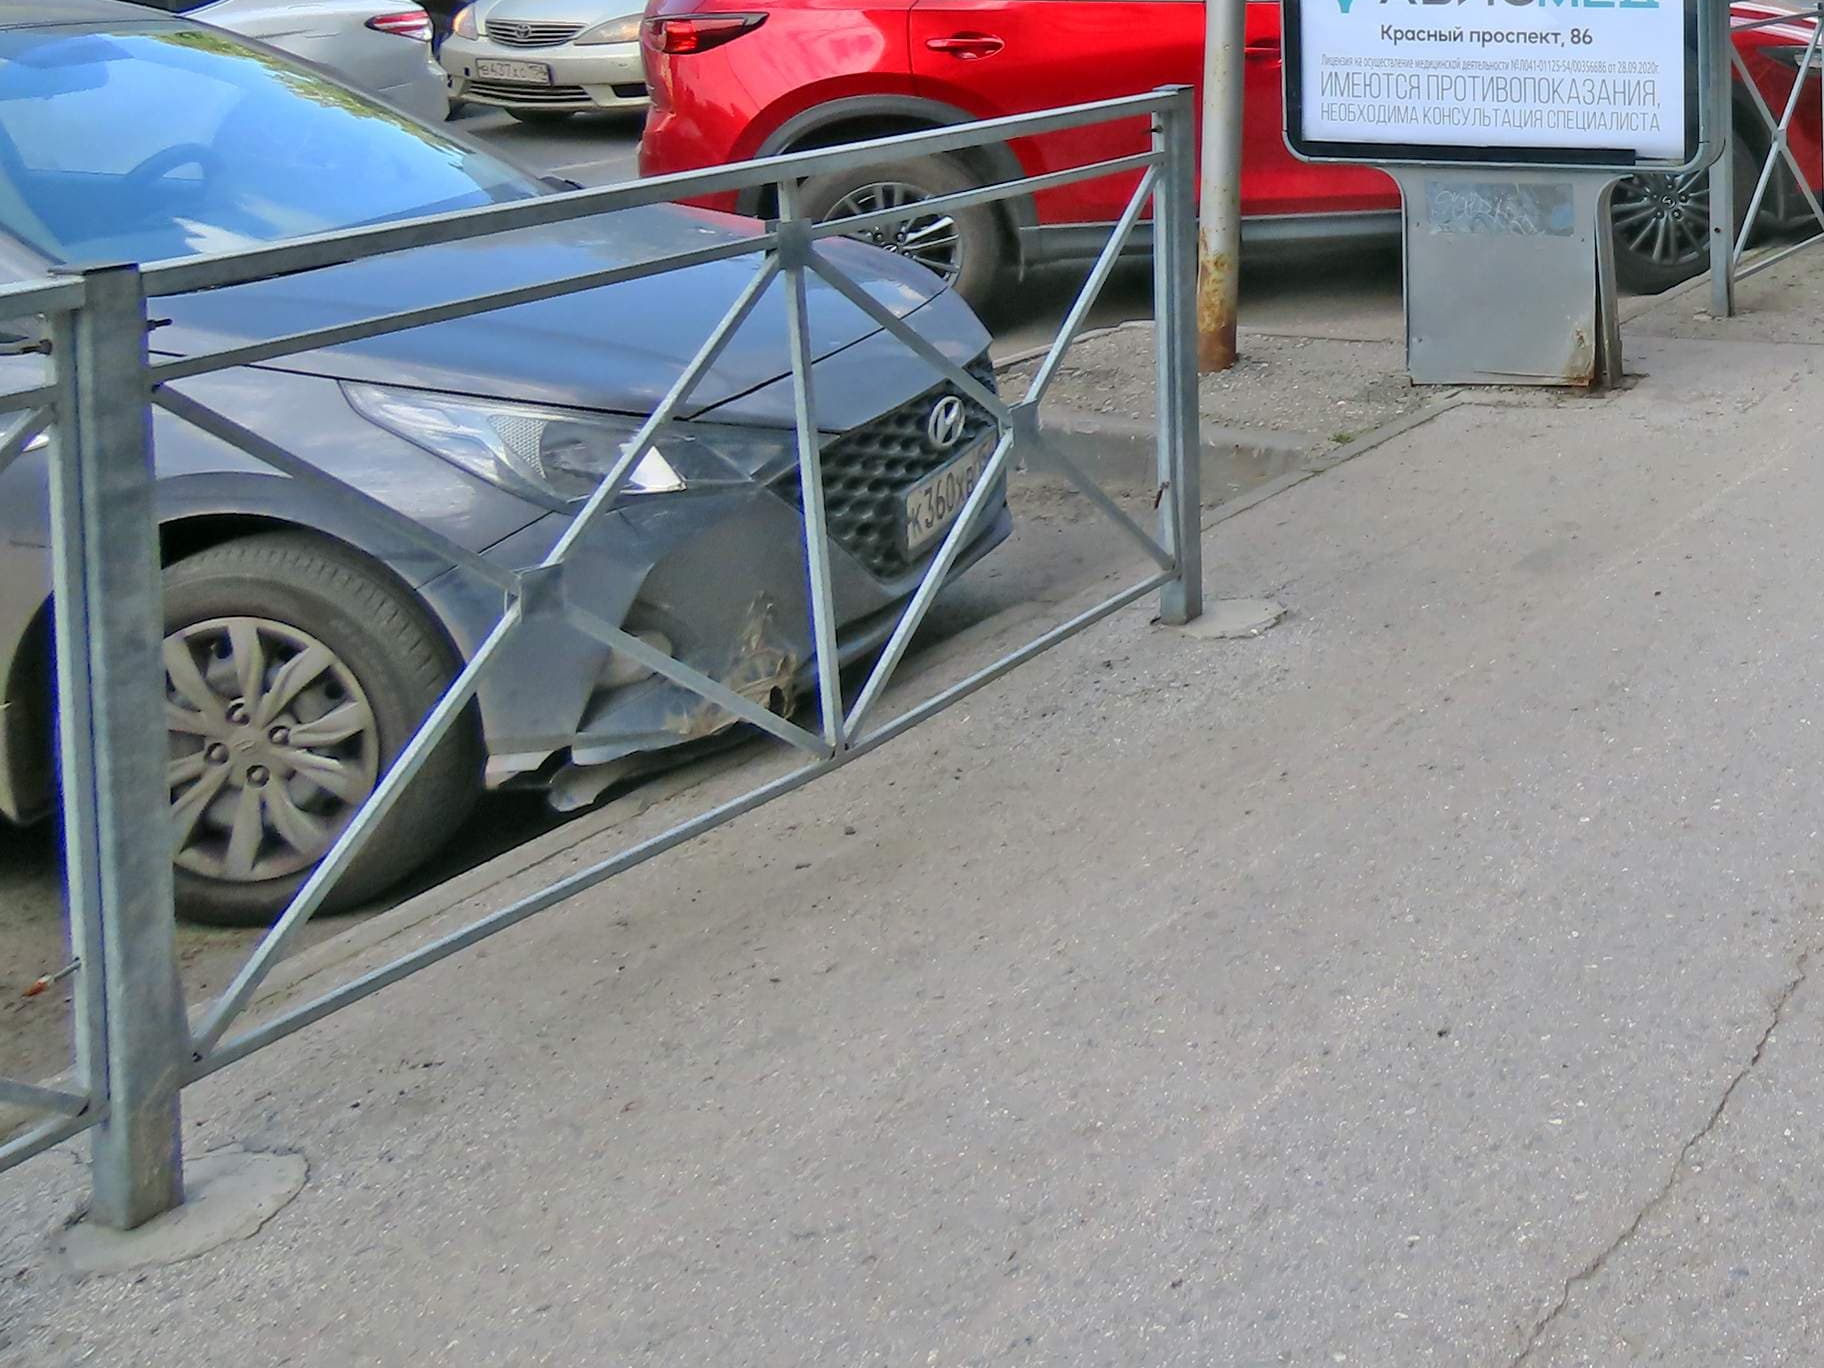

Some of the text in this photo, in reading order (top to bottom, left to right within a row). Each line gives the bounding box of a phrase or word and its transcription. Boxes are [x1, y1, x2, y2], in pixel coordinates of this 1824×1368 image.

[1380, 25, 1593, 48] Красный проспект, 86
[1320, 70, 1661, 109] ИМЕЮТСЯ ПРОТИВОПОКАЗАНИЯ,
[1320, 102, 1661, 132] НЕОБХОДИМА КОНСУЛЬТАЦИЯ СПЕЦИАЛИСТА
